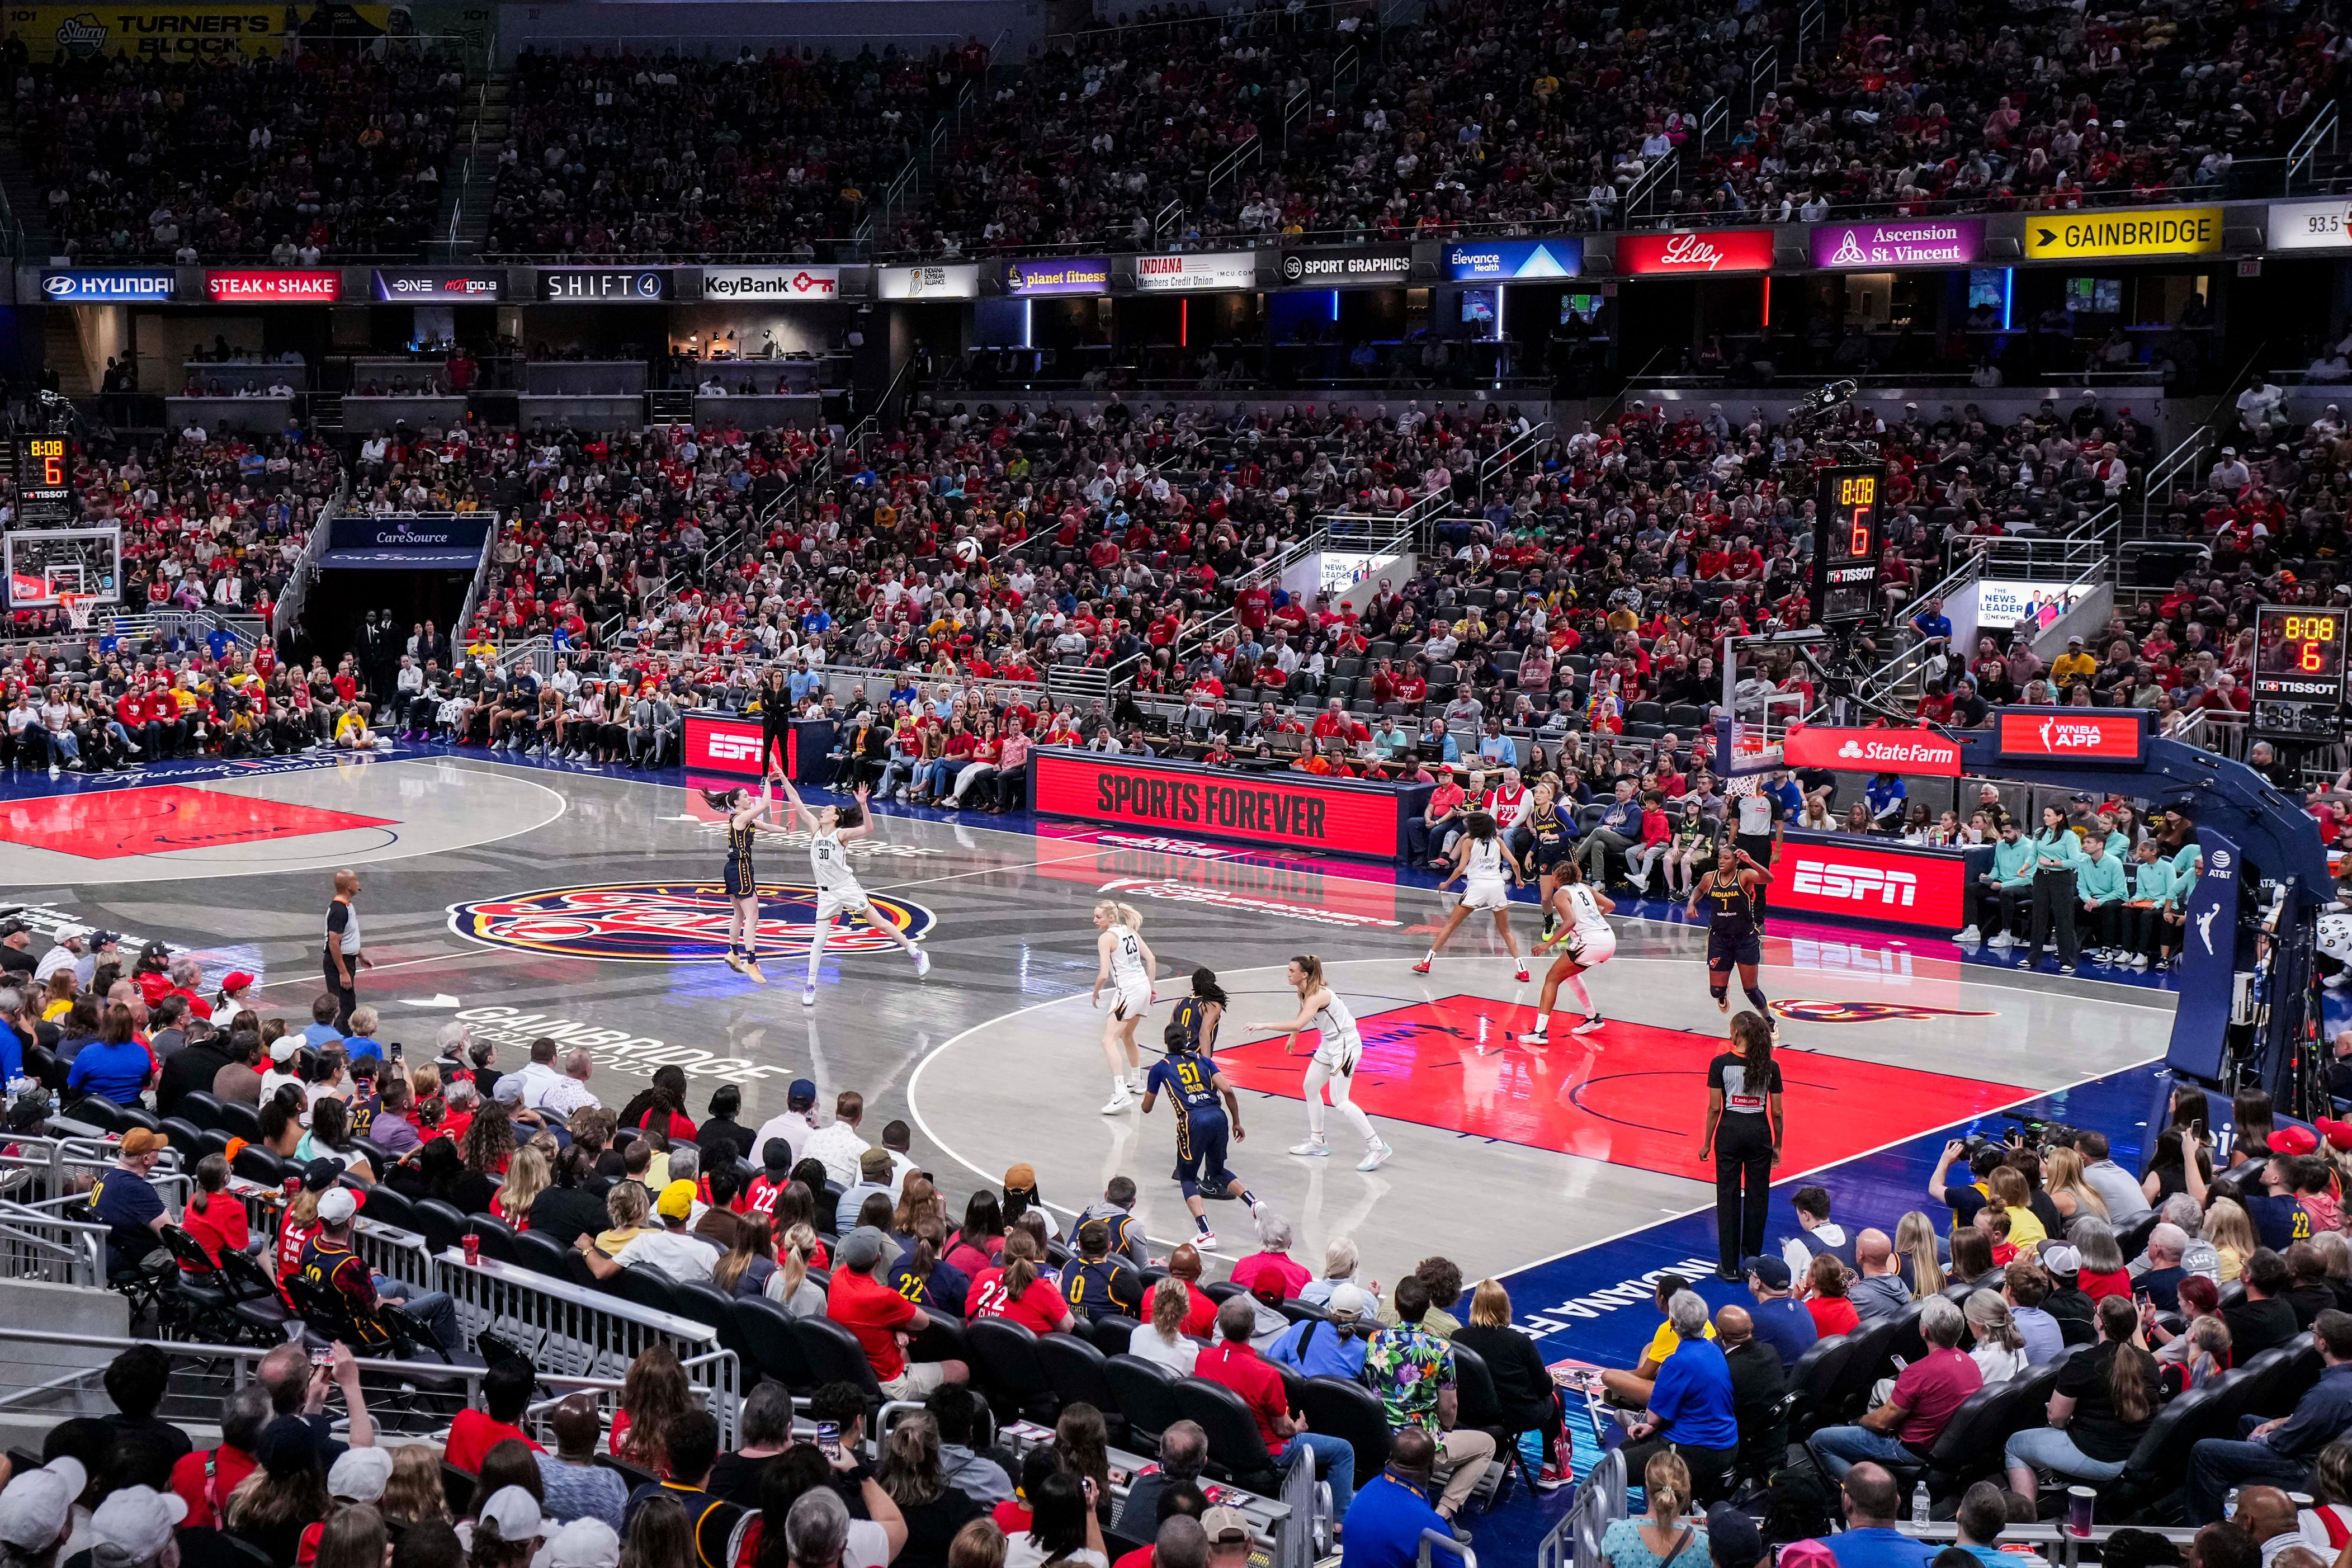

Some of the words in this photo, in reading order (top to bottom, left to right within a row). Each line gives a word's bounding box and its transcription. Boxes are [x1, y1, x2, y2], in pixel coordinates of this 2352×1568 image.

[117, 15, 270, 33] TURNER'S
[58, 18, 108, 48] Starry
[138, 37, 243, 54] BLOCK
[2065, 218, 2211, 247] GAINBRIDGE
[2309, 216, 2338, 233] 93.5
[1872, 226, 1957, 242] Ascension
[1452, 252, 1500, 265] Elevance
[1661, 234, 1723, 271] Lilly
[1871, 247, 1892, 262] St.
[1895, 246, 1960, 261] Vincent
[1139, 257, 1183, 274] INDIANA
[1287, 262, 1299, 273] SG
[1305, 259, 1345, 273] SPORT
[1348, 257, 1410, 272] GRAPHICS
[1474, 263, 1500, 272] Health
[82, 277, 174, 292] HYUNDAI
[210, 279, 263, 292] STEAK
[266, 281, 275, 290] N
[277, 279, 334, 292] SHAKE
[444, 278, 470, 291] HOT
[465, 280, 497, 290] 100.9
[549, 275, 632, 296] SHIFT
[643, 277, 654, 292] 4
[705, 277, 789, 295] KeyBank
[1027, 271, 1063, 287] planet
[1066, 270, 1106, 284] fitness
[1137, 276, 1169, 287] Members
[1170, 276, 1191, 286] Credit
[1193, 275, 1213, 286] Union
[2154, 400, 2161, 417] 5
[31, 441, 63, 456] 8:08
[45, 457, 62, 484] 6
[1842, 478, 1874, 504] 8:08
[376, 531, 448, 543] CareSource
[1852, 507, 1869, 555] 6
[1841, 567, 1875, 582] TISSOT
[1985, 594, 2016, 603] NEWS
[1980, 603, 2023, 613] LEADER
[2285, 617, 2334, 641] 8:08
[2302, 643, 2320, 671] 6
[1626, 689, 1634, 698] 22
[2279, 681, 2337, 695] TISSOT
[2055, 725, 2101, 734] WNBA
[2055, 734, 2101, 747] APP
[91, 765, 230, 783] Michelob
[1097, 773, 1199, 818] SPORTS
[1205, 785, 1326, 839] FOREVER
[1498, 804, 1519, 813] FEVER
[1500, 811, 1516, 823] 22
[819, 848, 829, 859] 30
[1482, 842, 1490, 857] 7
[2208, 869, 2232, 879] AT&T
[1162, 883, 1231, 896] WNBA
[1792, 860, 1917, 906] ESPN
[1125, 889, 1207, 902] CUP
[1578, 891, 1589, 906] 8
[1721, 898, 1727, 910] 7
[1144, 886, 1404, 926] COMMISSIONER'S
[1259, 909, 1359, 926] coinbase
[1123, 935, 1137, 955] 23
[1182, 1008, 1192, 1027] 0
[455, 1006, 794, 1084] GAINBRIDGE
[1177, 1061, 1201, 1085] 51
[1184, 1083, 1205, 1094] COLSON
[353, 1109, 371, 1128] 22
[753, 1186, 778, 1214] 22
[2293, 1212, 2310, 1239] 22
[899, 1273, 924, 1303] 22
[979, 1279, 1009, 1314] 22
[1069, 1276, 1085, 1303] 0
[1543, 1258, 1718, 1318] INDIANA
